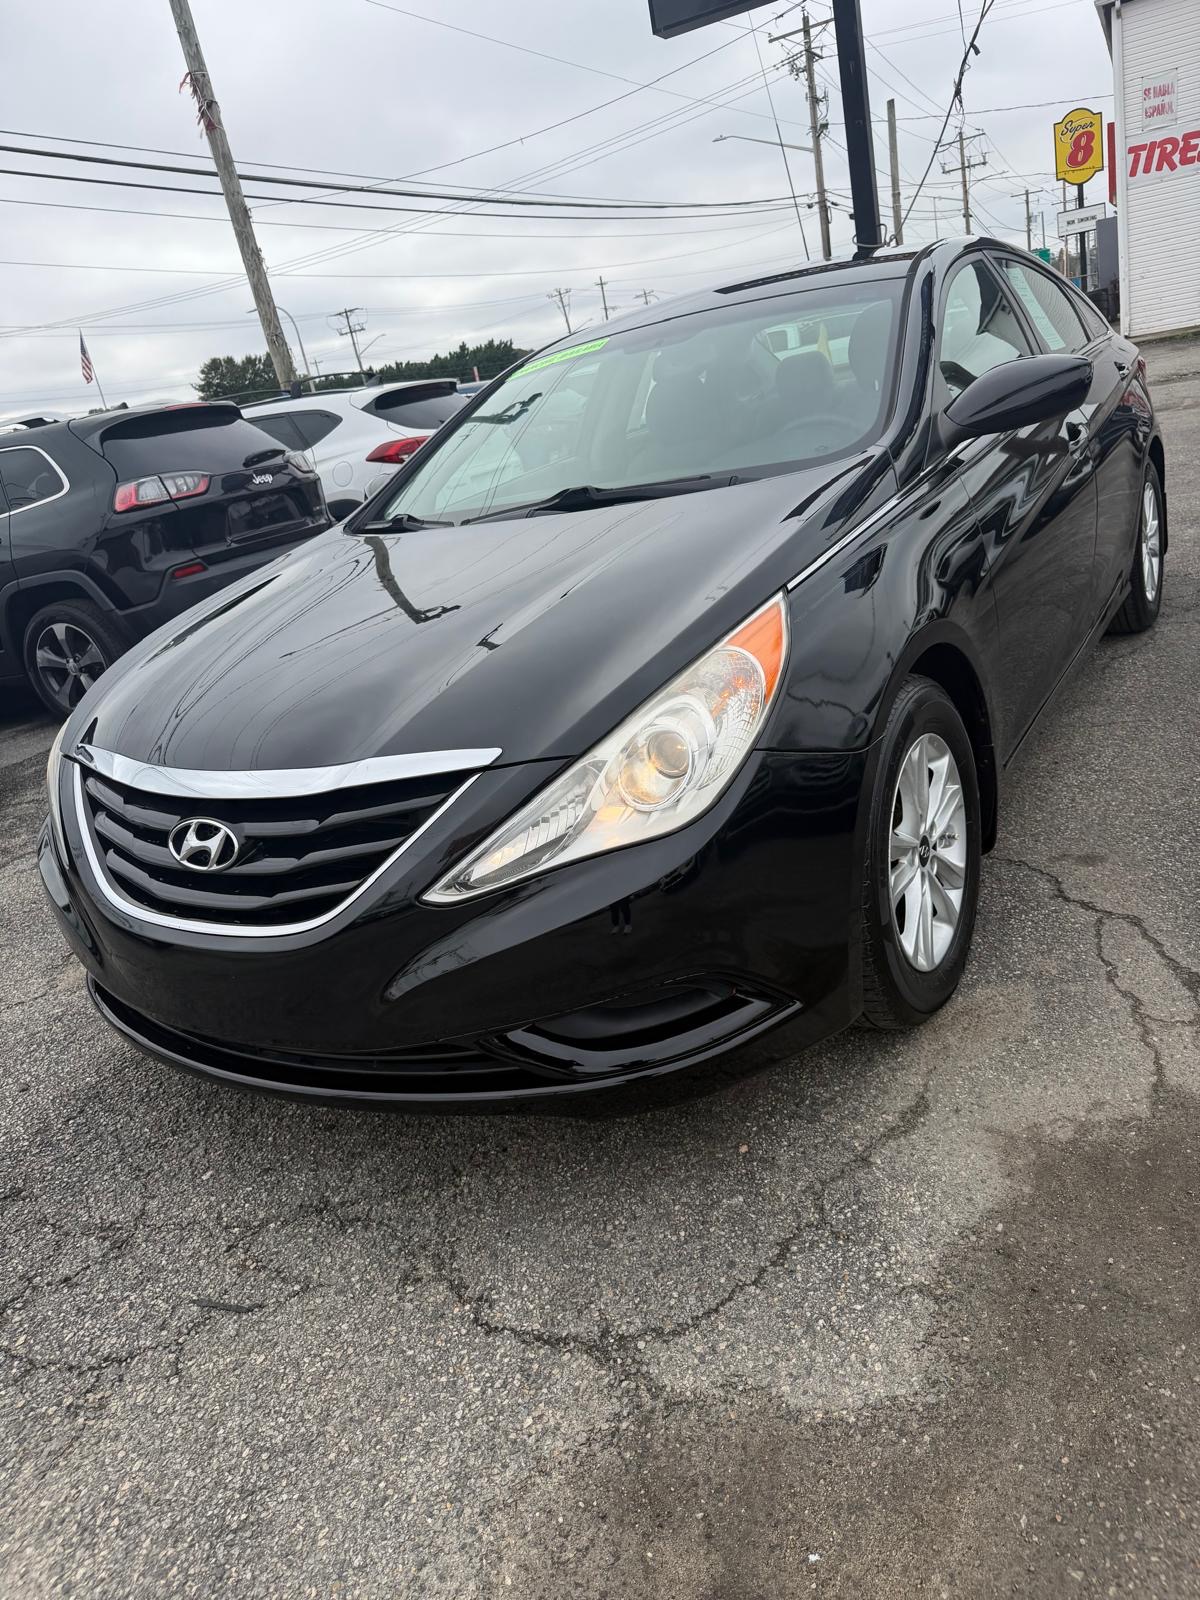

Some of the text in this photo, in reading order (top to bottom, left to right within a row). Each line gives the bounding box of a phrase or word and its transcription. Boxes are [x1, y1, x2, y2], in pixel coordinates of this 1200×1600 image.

[1060, 119, 1095, 141] Super
[1066, 130, 1096, 169] 8
[1127, 130, 1200, 178] TIRE
[252, 473, 273, 485] Jeep
